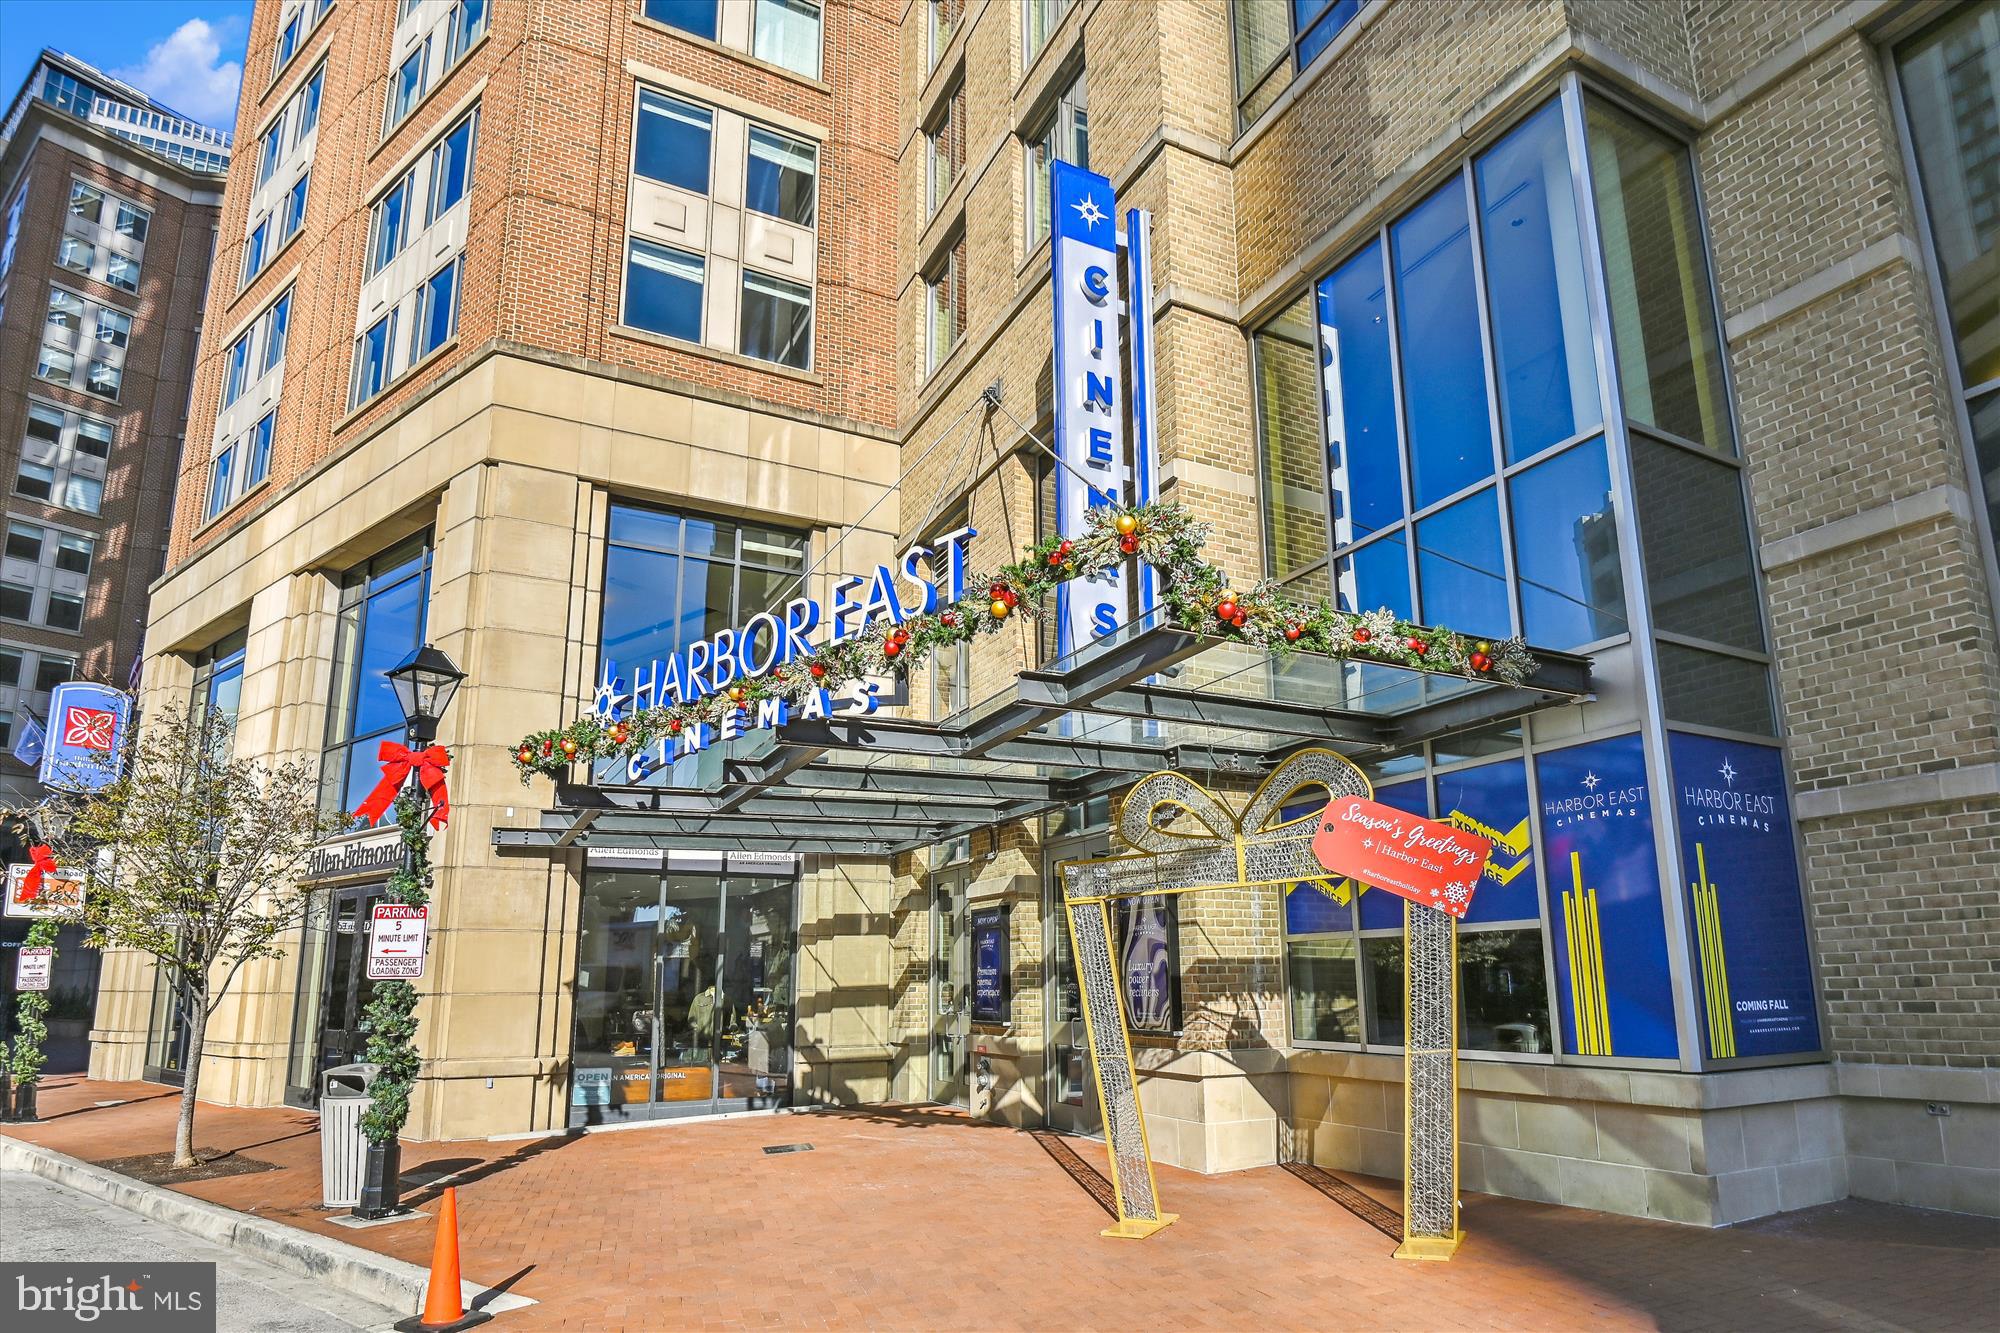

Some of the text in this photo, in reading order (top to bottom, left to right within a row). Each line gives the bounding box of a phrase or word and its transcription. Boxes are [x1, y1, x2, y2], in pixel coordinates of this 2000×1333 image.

[1080, 264, 1119, 646] CINEMS
[632, 526, 978, 714] HARBOR EAST
[628, 681, 880, 781] CINEMAS
[1545, 786, 1645, 815] HARBOR EAST
[1684, 786, 1775, 814] HARBOR EAST
[1556, 808, 1636, 827] CINEMAS
[1698, 815, 1769, 832] CINEMAS
[1341, 803, 1480, 866] Season's Greetings
[306, 841, 407, 876] Allen Edmond
[730, 852, 792, 861] Allen Edmonds
[1381, 845, 1444, 874] Harbor East
[1362, 867, 1421, 895] #harboreastholiday
[1128, 895, 1160, 906] NOW OPEN
[377, 908, 425, 918] PARKING
[396, 921, 402, 930] 5
[378, 933, 419, 943] MINUTE LIMIT
[1128, 962, 1154, 974] Luxury
[1128, 975, 1150, 985] power
[1128, 986, 1160, 997] recliners
[1736, 999, 1789, 1012] COMING FALL
[577, 1073, 609, 1081] OPEN
